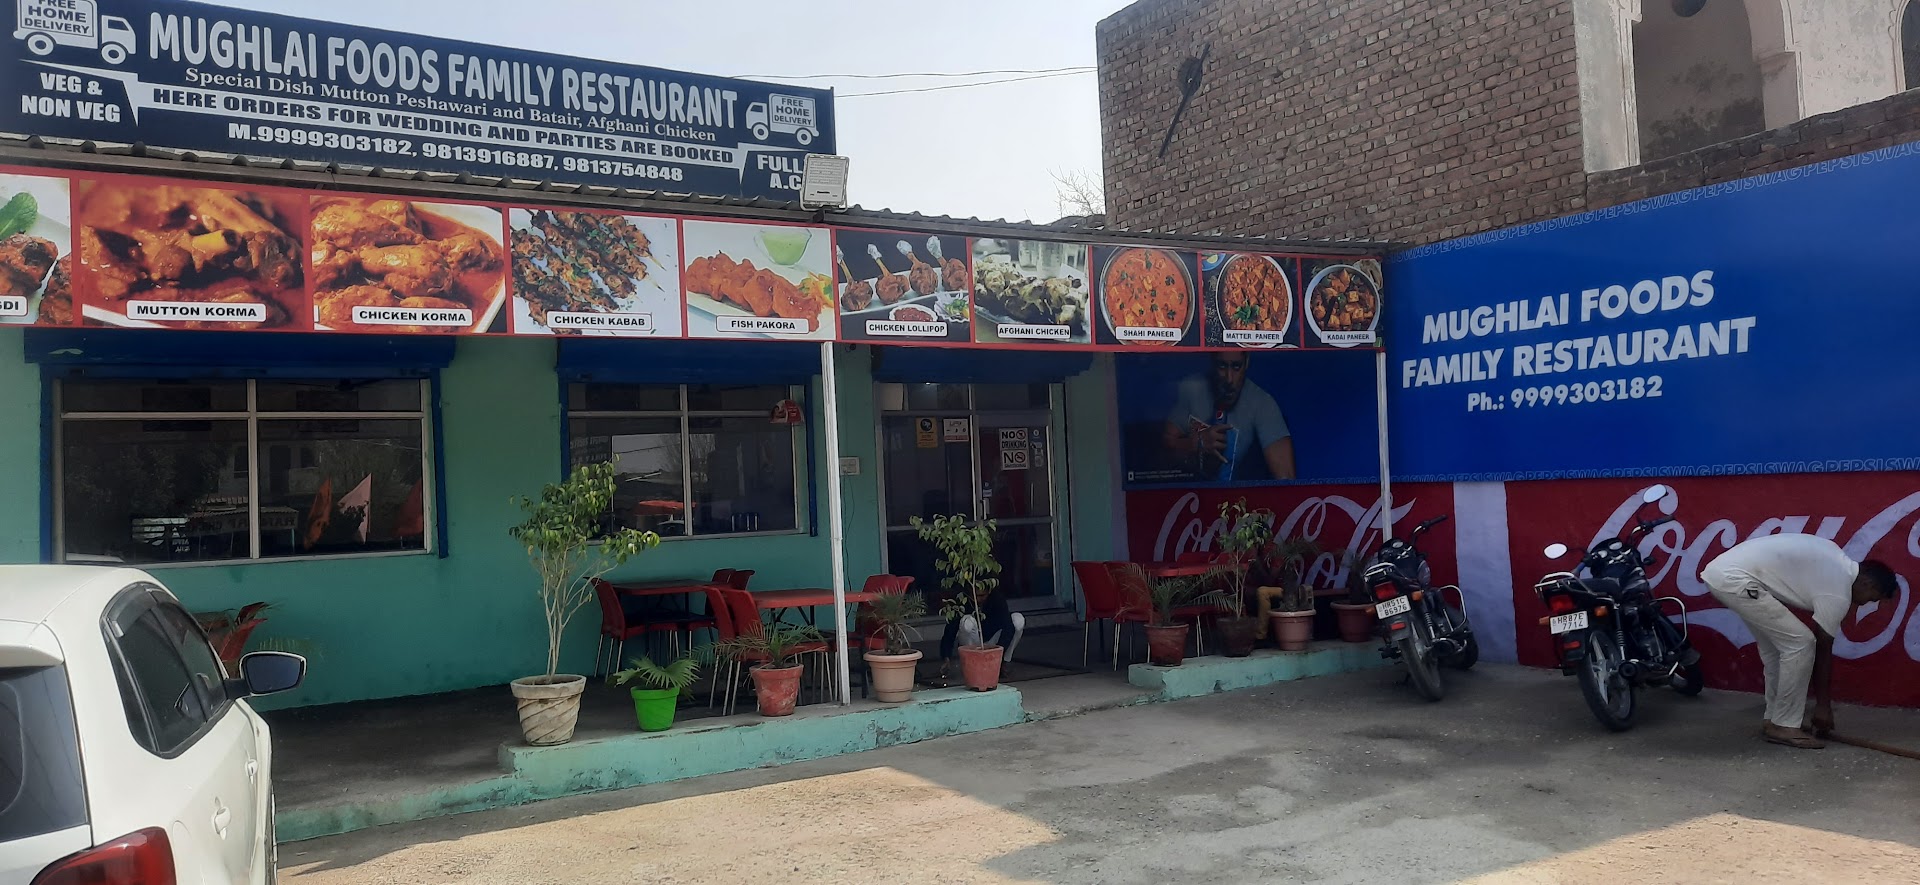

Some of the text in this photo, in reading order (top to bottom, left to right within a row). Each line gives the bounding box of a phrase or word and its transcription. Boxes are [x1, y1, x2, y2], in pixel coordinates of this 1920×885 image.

[28, 5, 86, 23] HOME
[25, 17, 90, 34] DELIVERY
[150, 12, 737, 129] MUGHLAI FOODS FAMILY RESTAURANT
[40, 72, 102, 95] VEG &
[21, 95, 120, 122] NON VEG
[185, 66, 717, 142] Special Dish Mutton Peshawari and Batair, Afghani Chicken
[781, 97, 804, 107] FREE
[776, 105, 810, 117] HOME
[153, 88, 734, 164] HERE ORDERS FOR WEDDING AND PARTIES ARE BOOKED
[774, 115, 812, 126] DELIVERY
[228, 123, 683, 182] M.9999303182, 9813916887, 9813754848
[136, 305, 258, 318] MUTTON KORMA
[1422, 270, 1715, 344] MUGHLAI FOODS
[359, 310, 466, 323] CHICKEN KORMA
[553, 315, 646, 327] CHICKEN KABAB
[730, 319, 796, 330] FISH PAKORA
[869, 323, 945, 333] CHICKEN LOLLIPOP
[999, 326, 1070, 336] AFGHANI CHICKEN
[1123, 329, 1175, 338] SHAHI PANEER
[1225, 332, 1253, 340] MATTER
[1326, 333, 1370, 341] KADAI PANEER
[1402, 316, 1757, 388] FAMILY RESTAURANT
[1467, 375, 1663, 412] Ph.: 9999303182
[1002, 431, 1015, 439] NO
